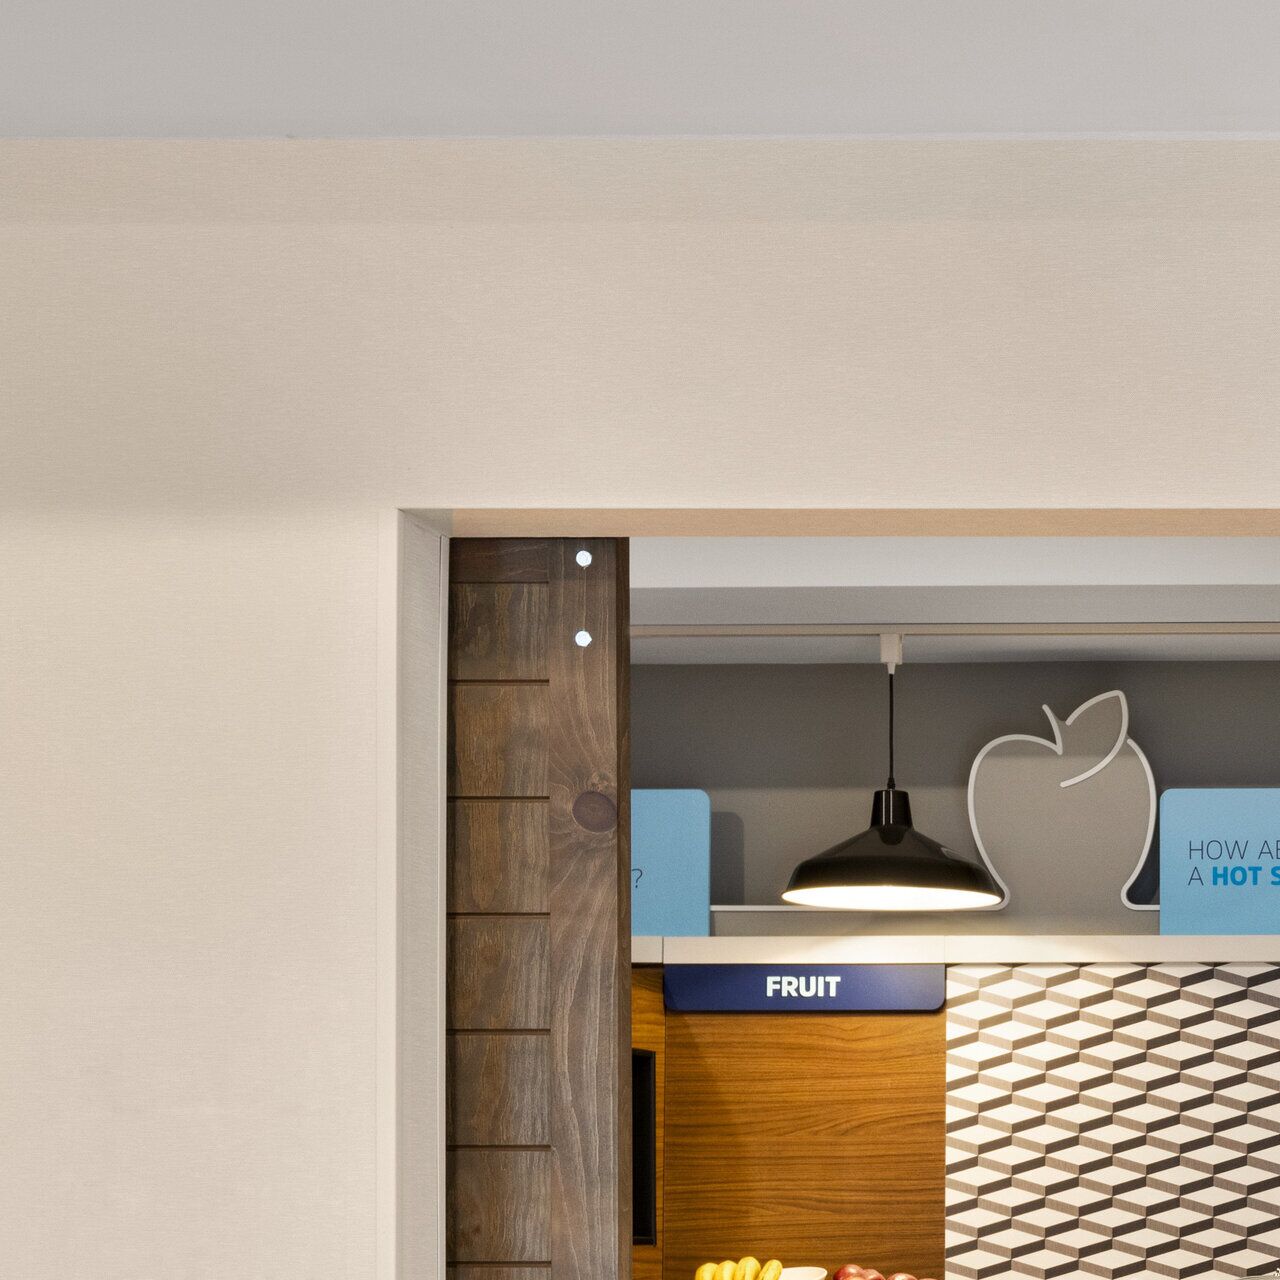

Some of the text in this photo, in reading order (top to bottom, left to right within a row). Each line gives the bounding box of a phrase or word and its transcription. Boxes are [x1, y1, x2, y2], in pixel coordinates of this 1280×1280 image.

[1189, 839, 1249, 860] HOW
[1187, 866, 1204, 886] A
[1212, 866, 1263, 886] HOT
[766, 975, 841, 997] FRUIT
